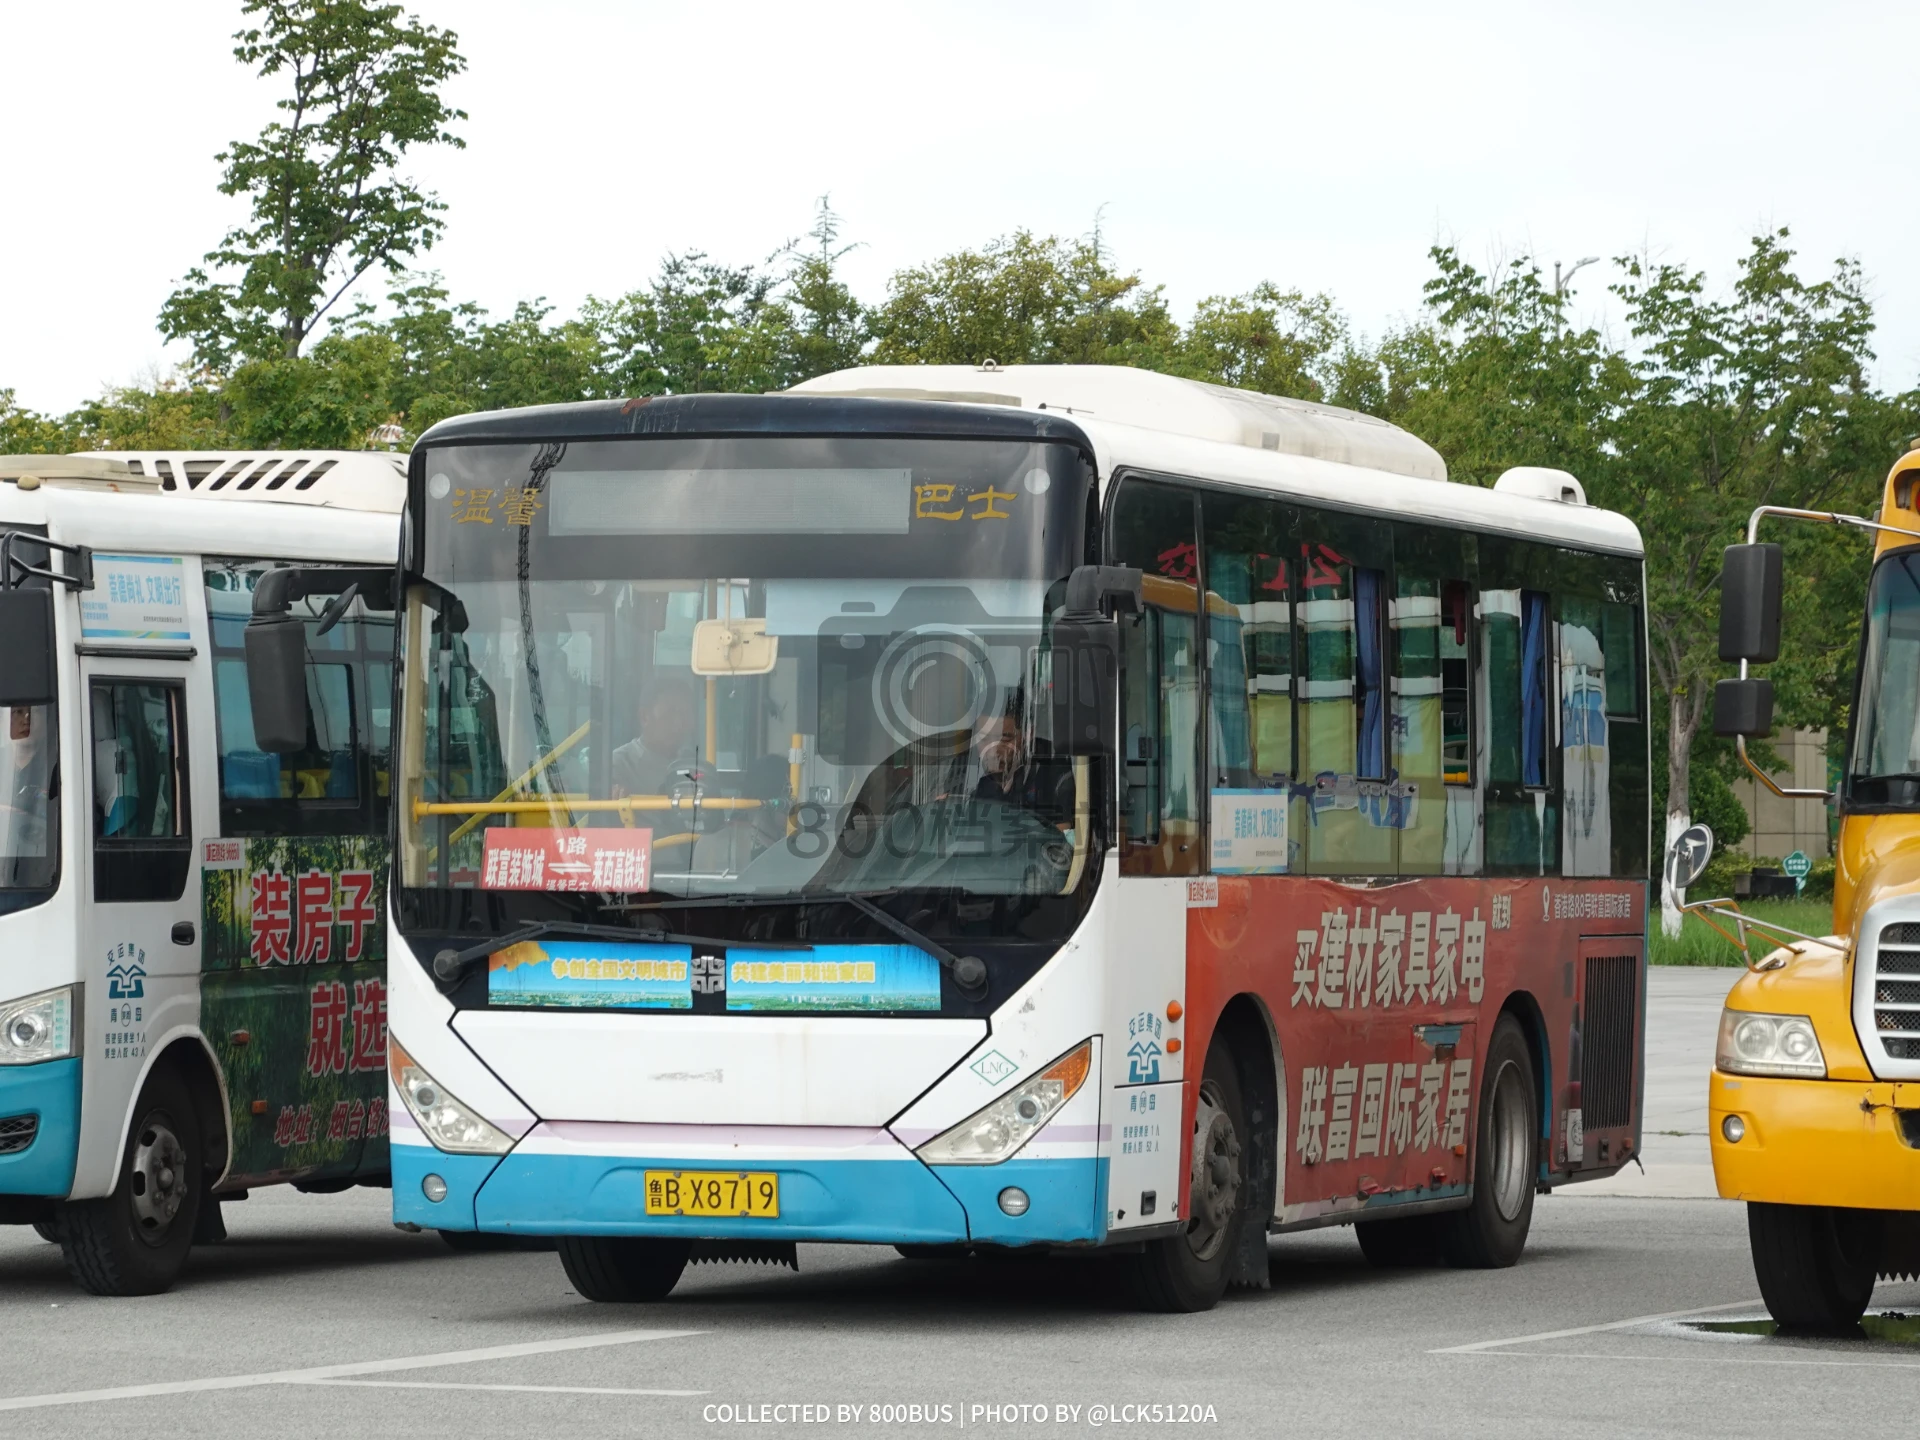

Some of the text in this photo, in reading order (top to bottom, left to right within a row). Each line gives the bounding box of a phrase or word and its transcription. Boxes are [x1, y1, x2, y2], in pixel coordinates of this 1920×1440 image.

[450, 488, 544, 525] 温馨
[914, 484, 1018, 520] 巴士
[556, 836, 587, 855] 1路
[485, 847, 647, 889] 联富装饰城 莱西高铁站
[251, 868, 376, 966] 装房子
[107, 943, 146, 966] 交运集团
[551, 957, 688, 982] 争创全国文明城市
[731, 961, 876, 984] 共建美丽和谐家园
[1291, 905, 1486, 1009] 买建材家具家电
[307, 977, 388, 1077] 就选
[1128, 1012, 1162, 1040] 交运集团
[981, 1061, 1009, 1074] LNG
[1296, 1058, 1473, 1164] 联富国际家居
